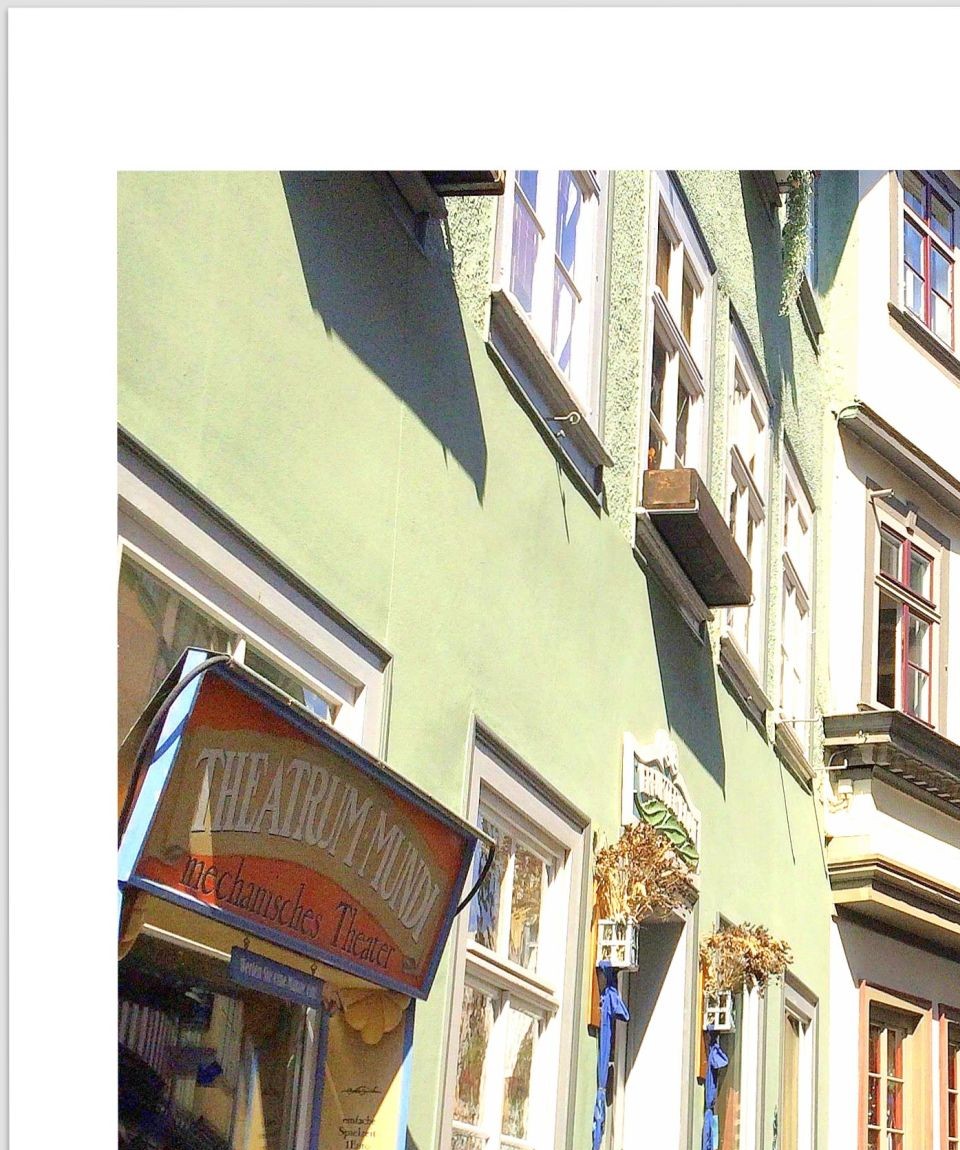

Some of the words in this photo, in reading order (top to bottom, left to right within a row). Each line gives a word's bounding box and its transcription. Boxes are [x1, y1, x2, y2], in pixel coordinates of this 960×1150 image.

[178, 855, 322, 938] mechanisches
[329, 900, 396, 969] Theater
[190, 747, 373, 868] THEATRUM
[357, 810, 440, 943] MUNDI
